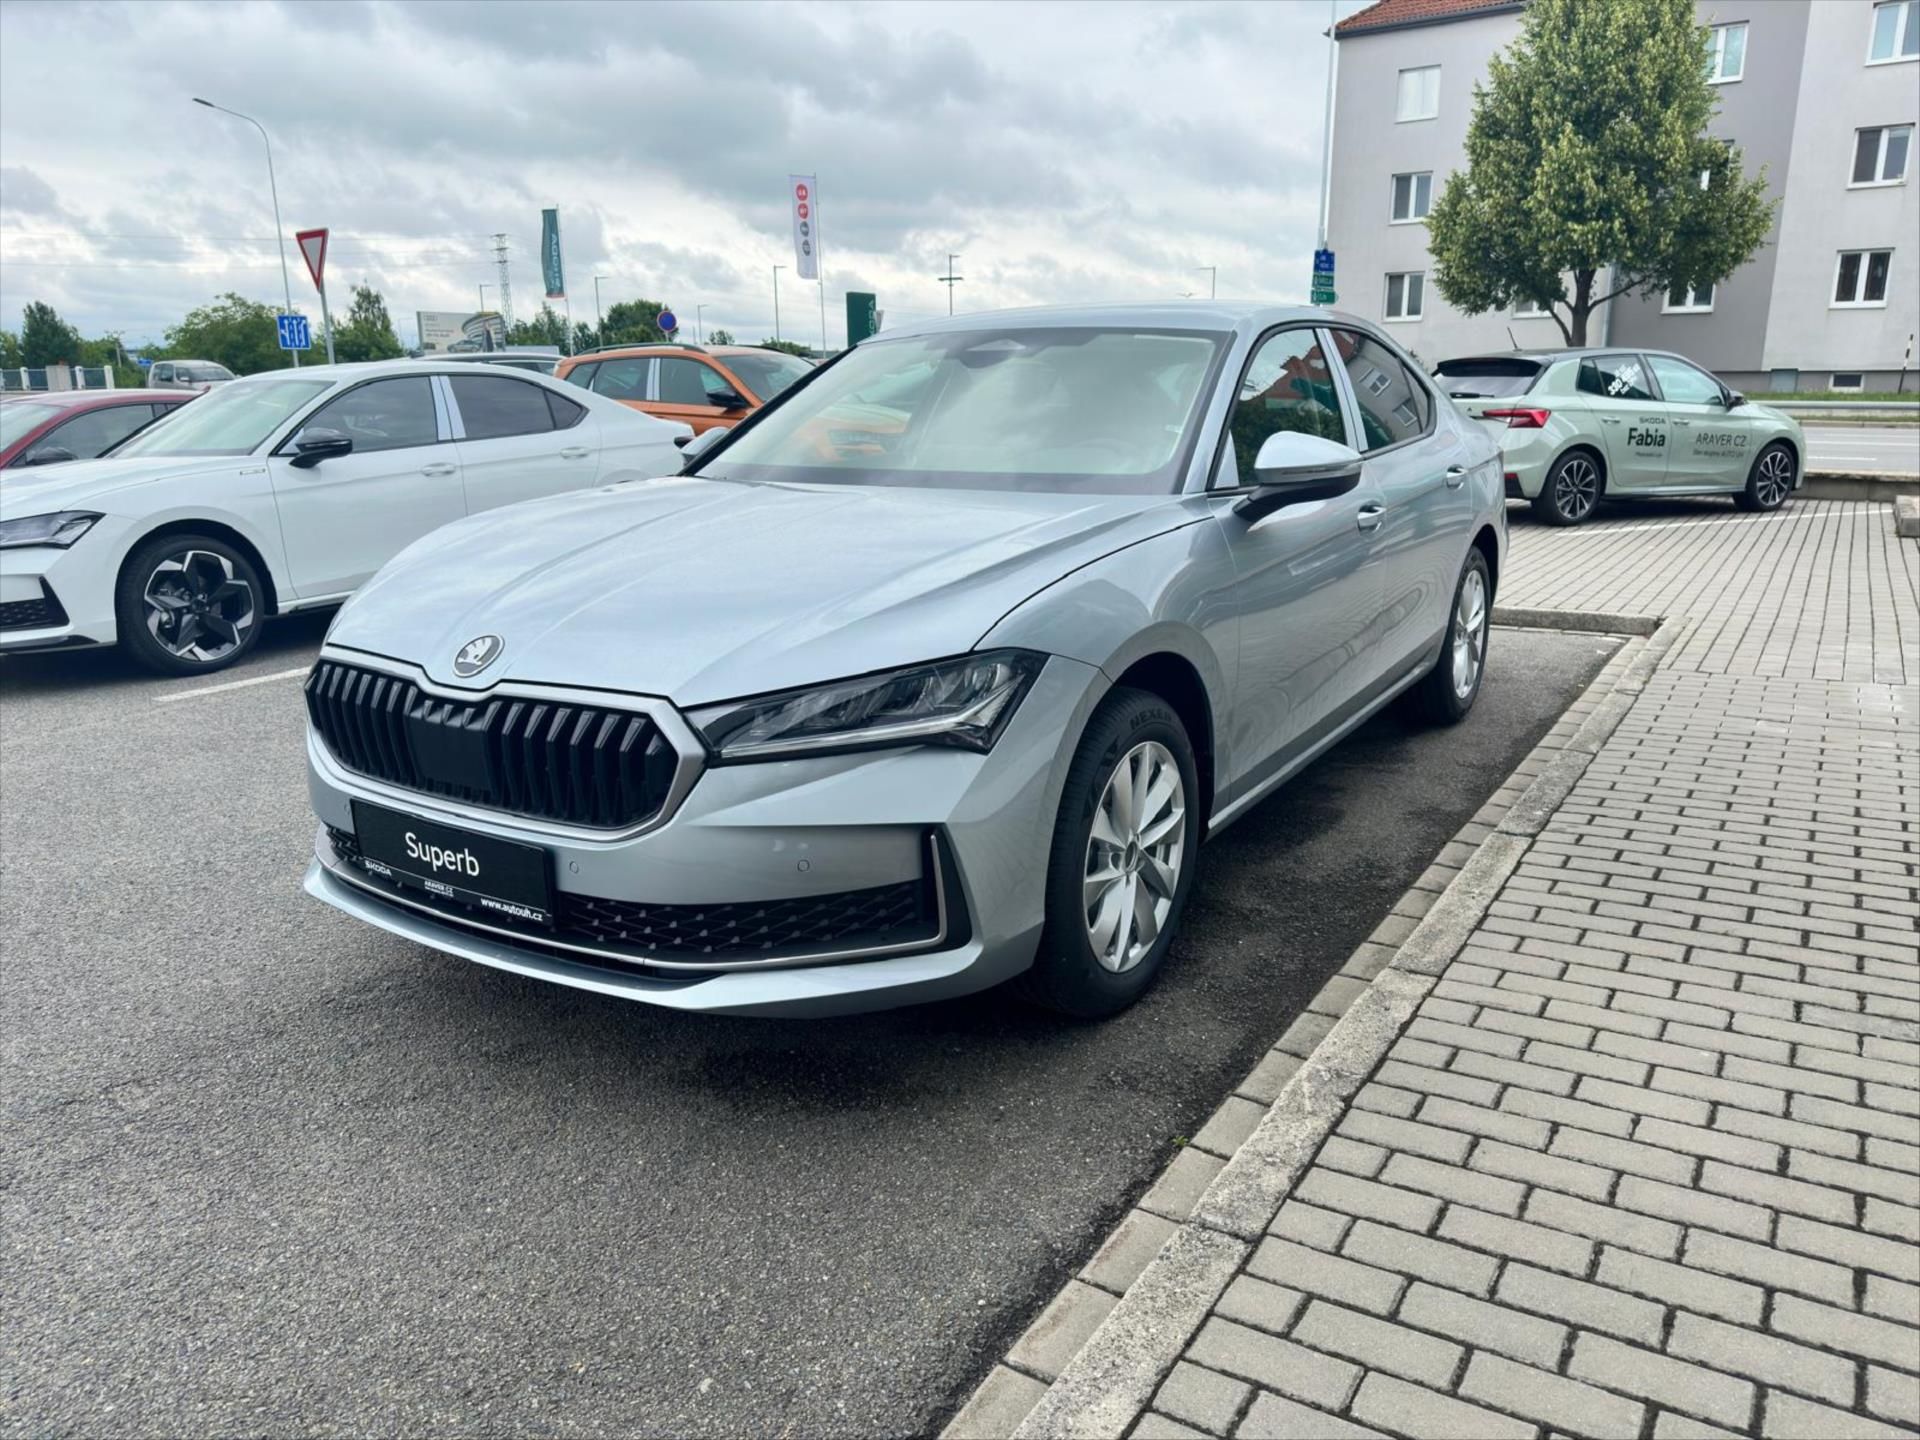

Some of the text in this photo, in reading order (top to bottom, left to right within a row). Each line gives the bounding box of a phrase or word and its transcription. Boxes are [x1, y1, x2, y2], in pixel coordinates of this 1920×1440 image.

[1627, 427, 1666, 447] Fabia
[1695, 432, 1748, 448] ARAVER CZ
[405, 831, 480, 877] Superb
[480, 897, 544, 922] www.autouh.cz
